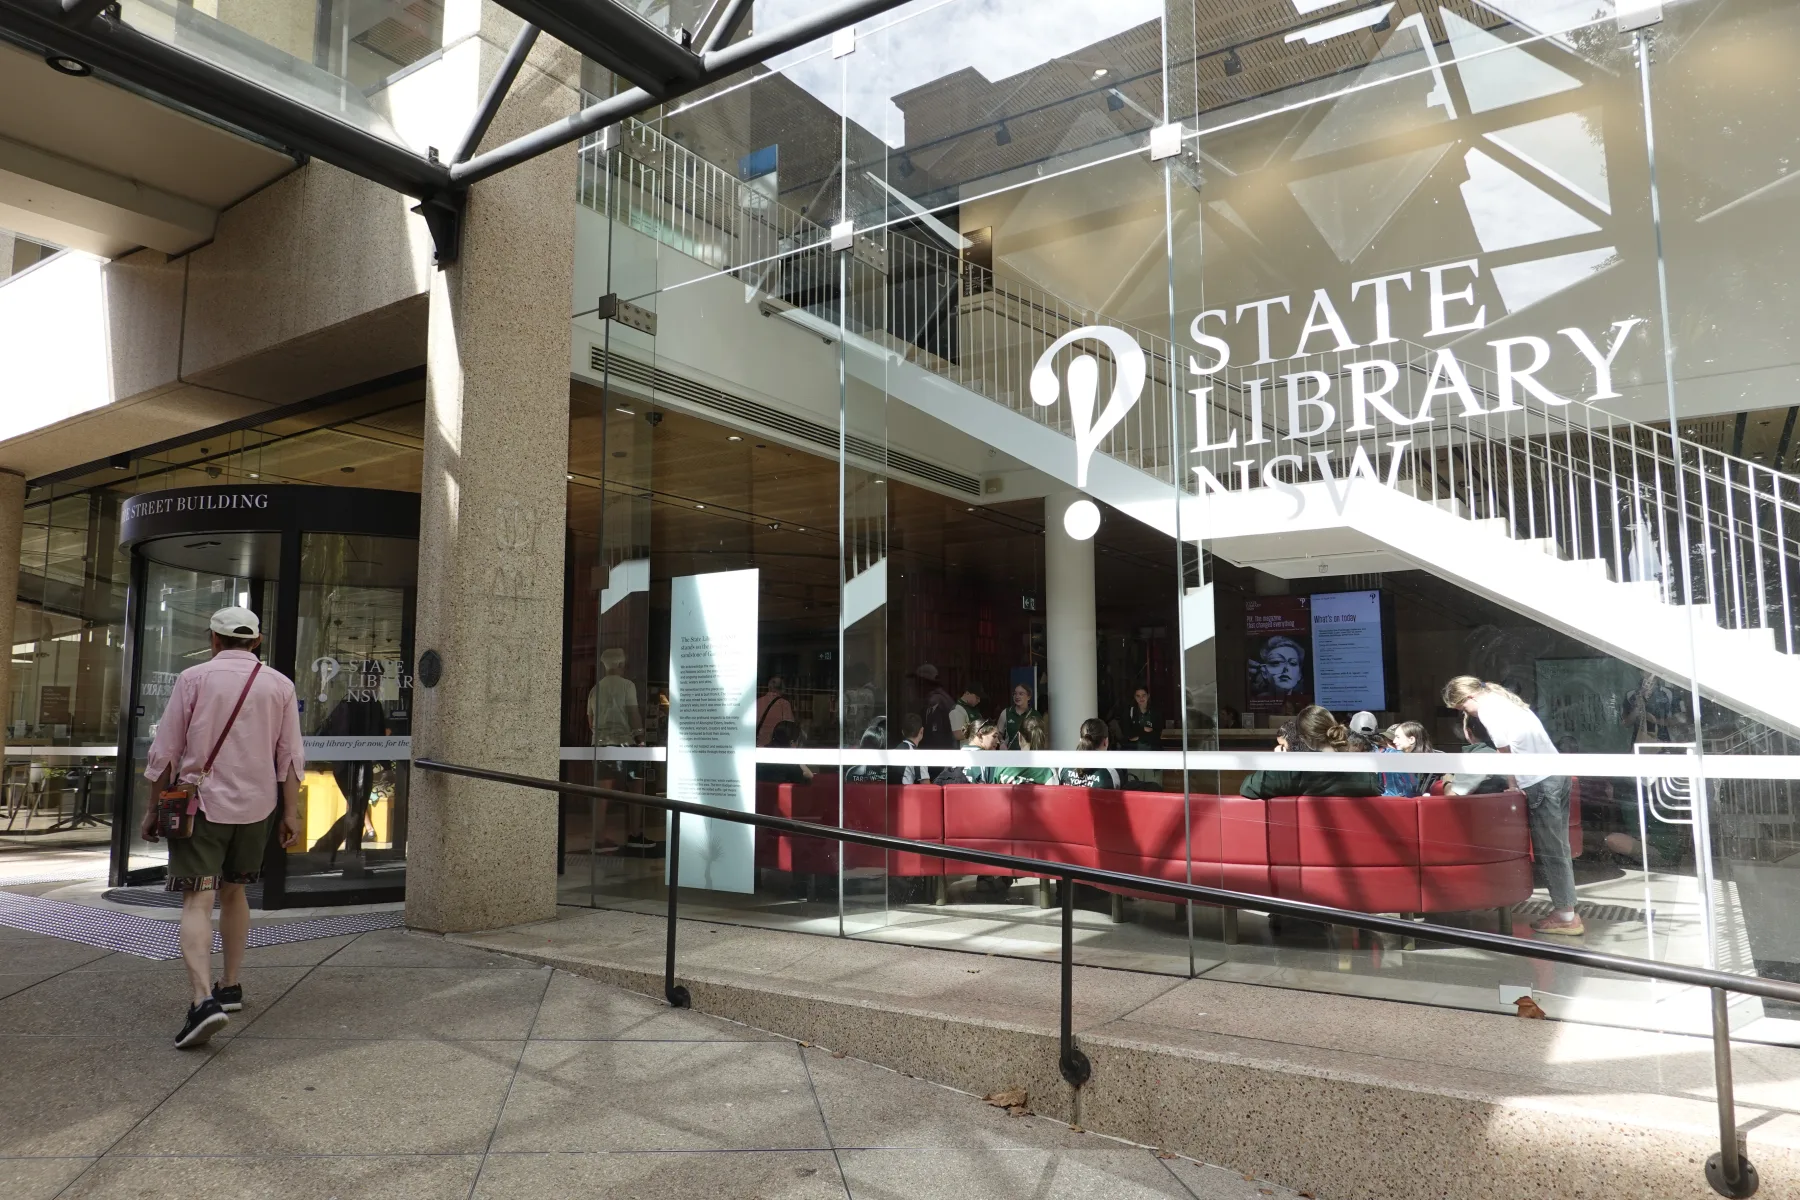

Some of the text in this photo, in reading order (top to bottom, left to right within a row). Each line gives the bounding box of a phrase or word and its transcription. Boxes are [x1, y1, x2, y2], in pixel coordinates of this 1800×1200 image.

[1188, 258, 1486, 376] STATE
[1187, 317, 1641, 453] LIBRARY
[1190, 440, 1412, 521] NSW
[131, 498, 173, 518] STREET
[176, 493, 268, 511] BUILDING
[1313, 614, 1357, 624] What's on today
[348, 659, 404, 674] STAE
[302, 740, 324, 748] living
[326, 740, 354, 748] library
[353, 740, 367, 748] for
[384, 740, 397, 748] for
